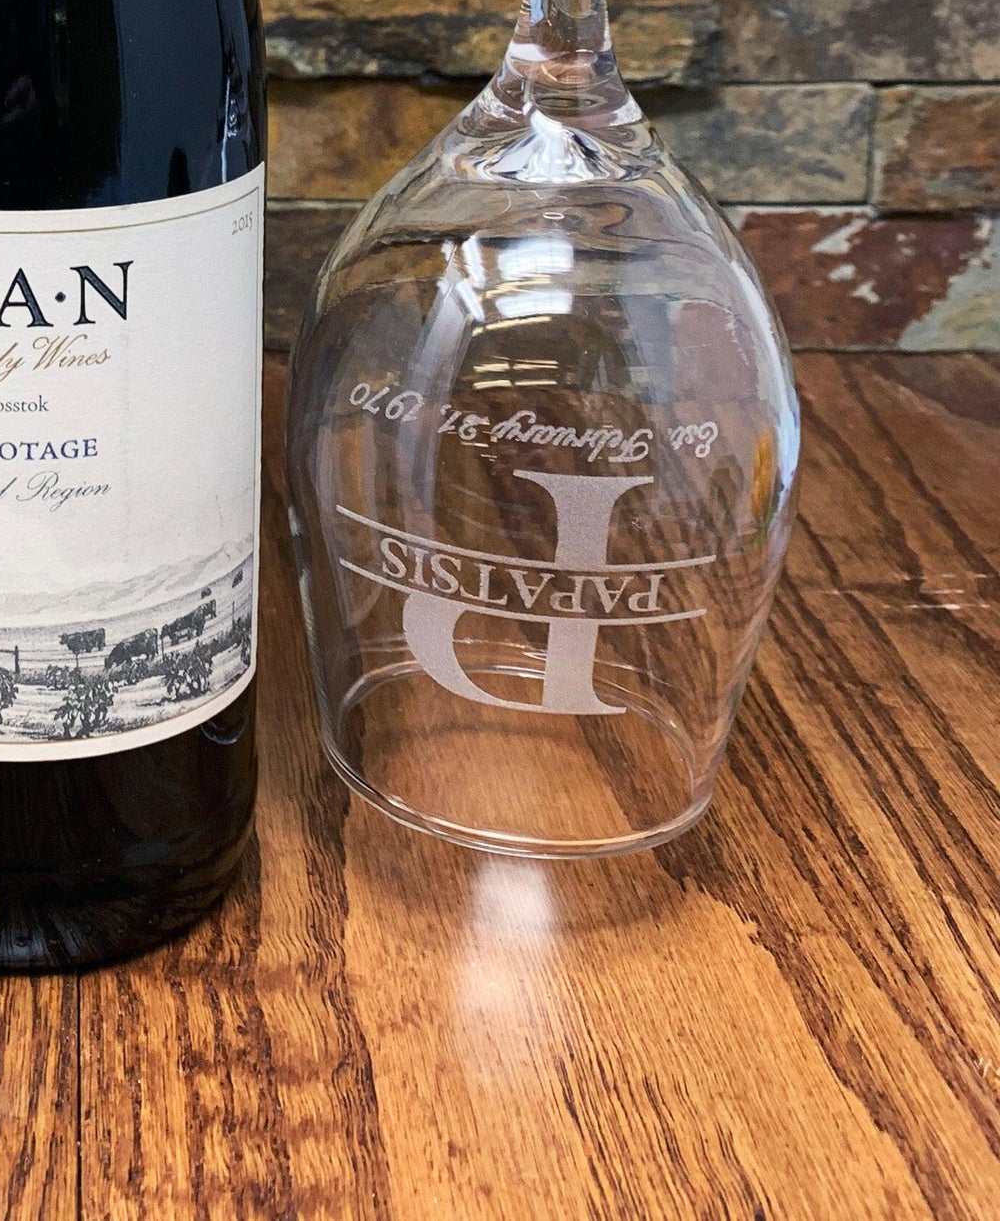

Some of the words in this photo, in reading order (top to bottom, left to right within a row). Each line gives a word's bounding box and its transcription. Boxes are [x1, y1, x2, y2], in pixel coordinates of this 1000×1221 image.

[231, 210, 253, 236] 2015
[31, 333, 112, 371] Wines
[348, 381, 425, 423] 1970
[491, 409, 654, 463] February
[15, 471, 112, 512] Region
[380, 536, 665, 615] PAPATSIS
